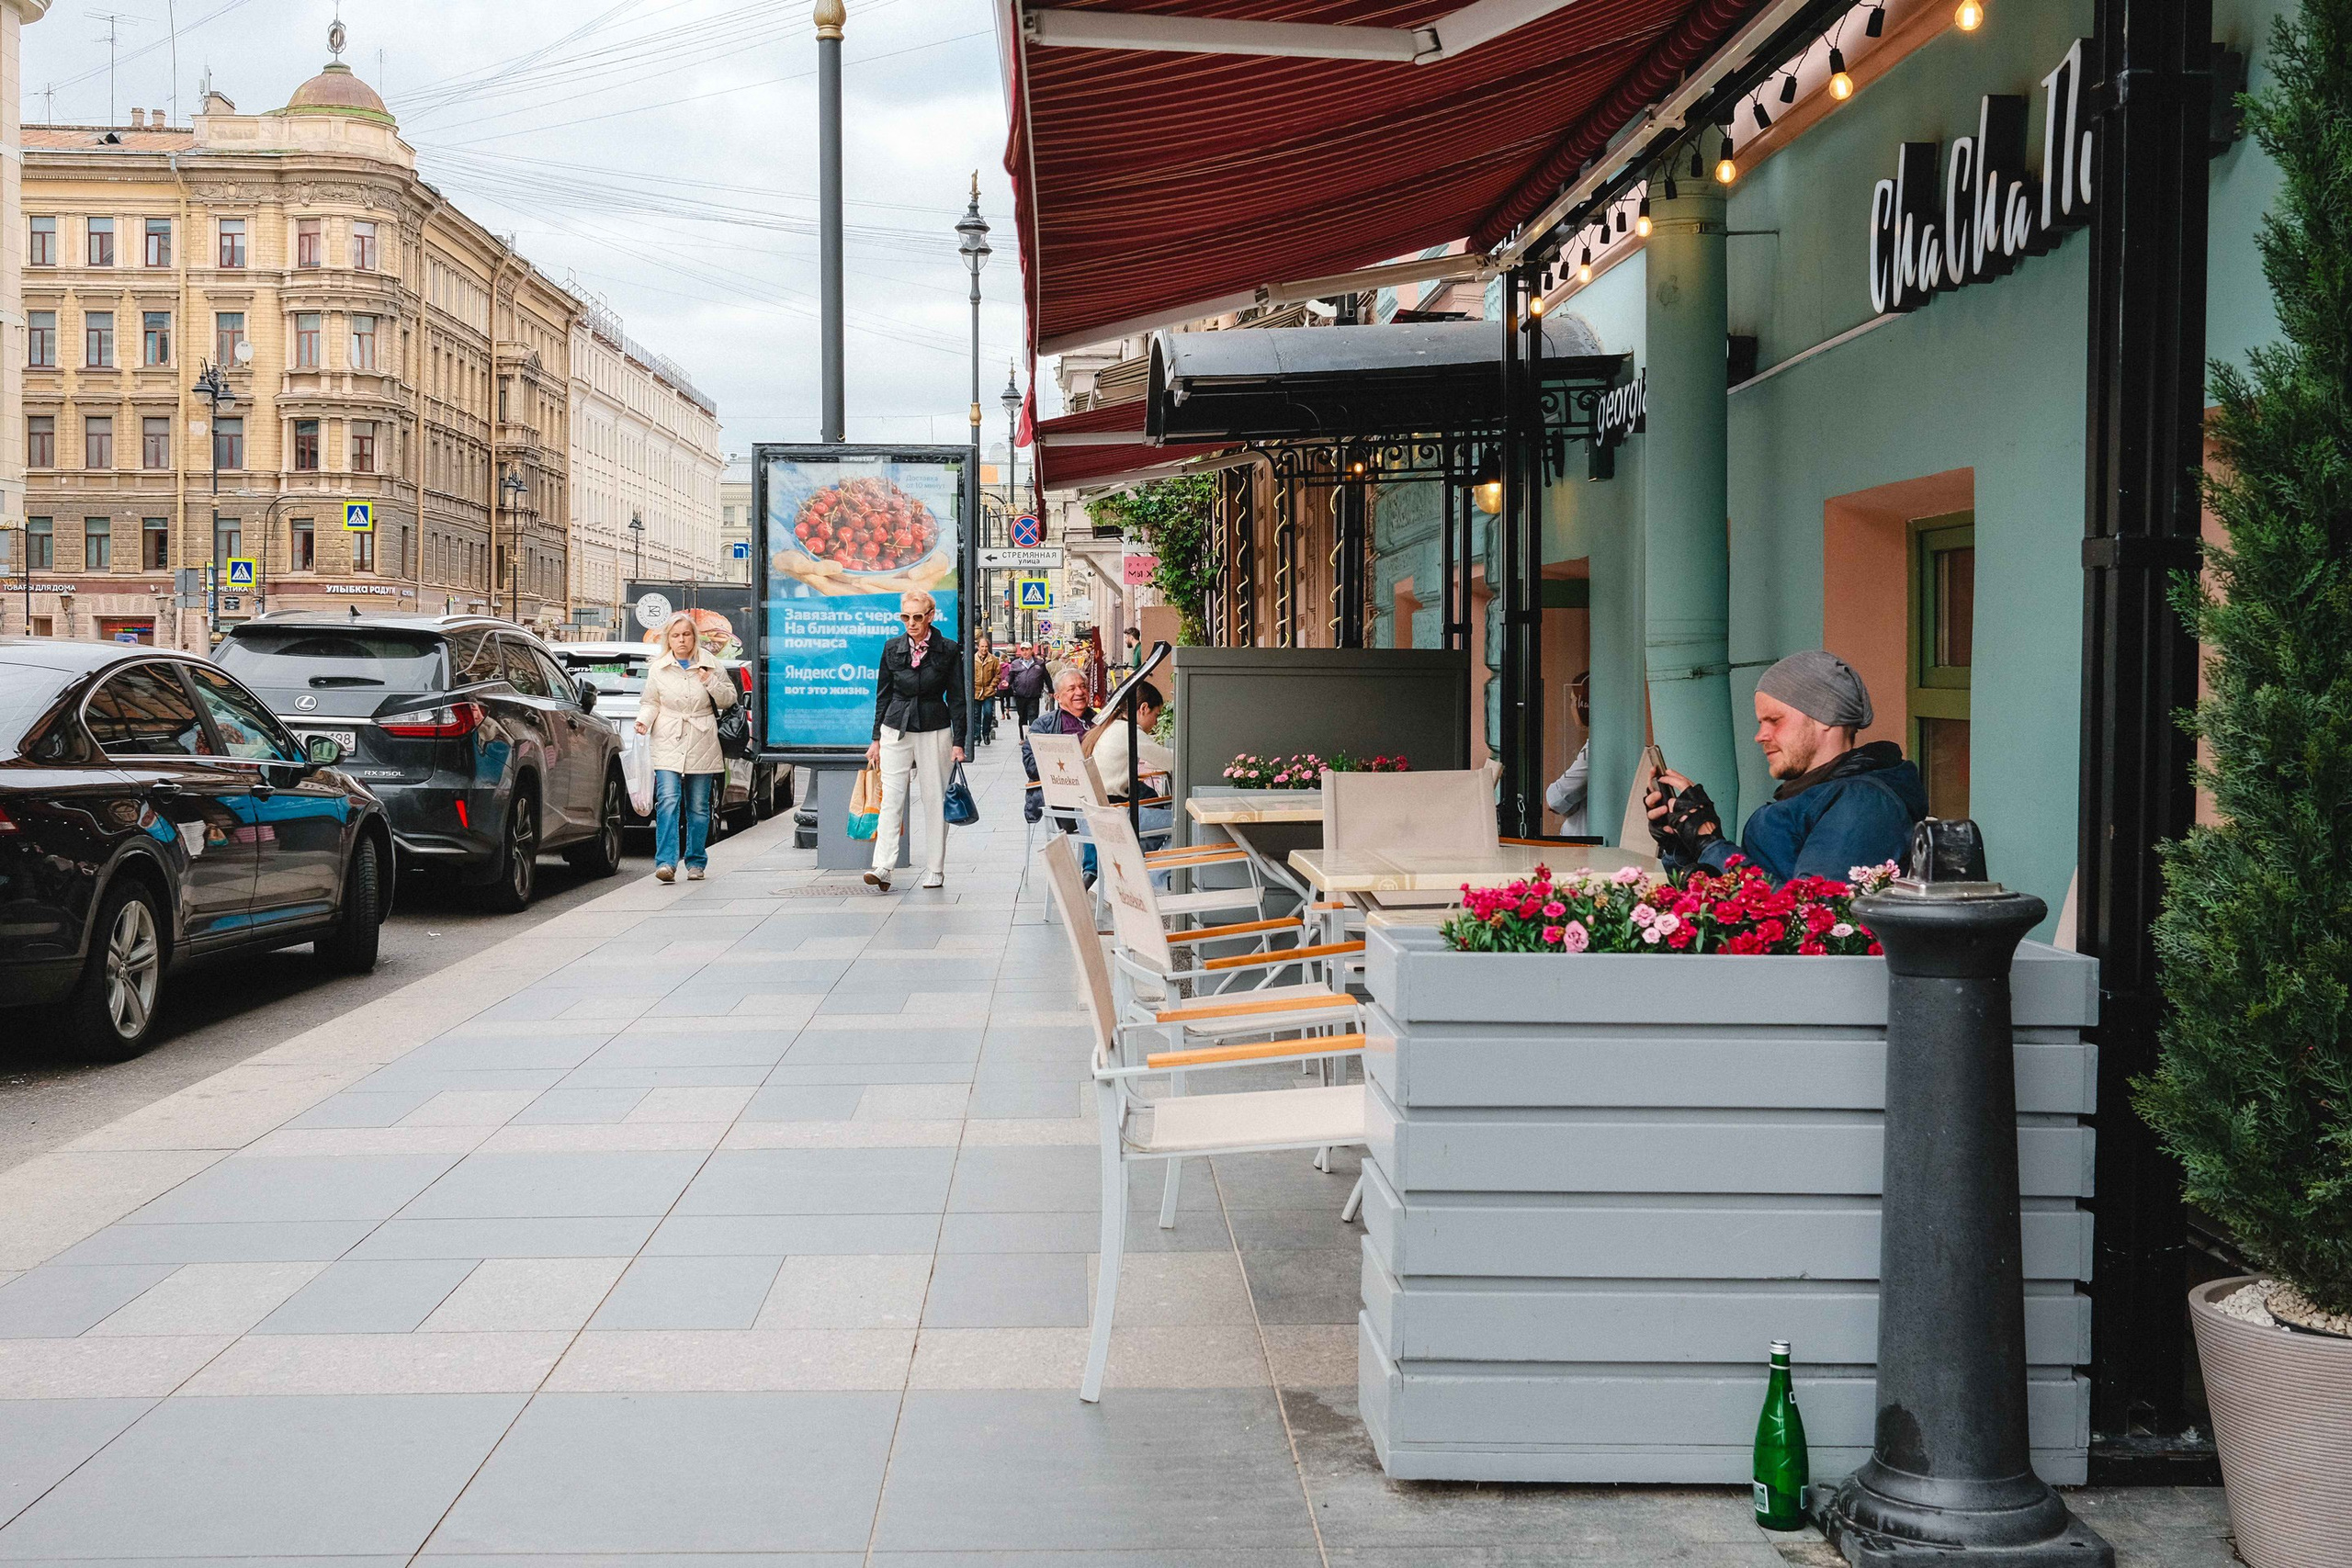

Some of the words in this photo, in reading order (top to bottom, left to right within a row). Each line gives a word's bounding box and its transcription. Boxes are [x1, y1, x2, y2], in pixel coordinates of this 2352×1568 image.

[906, 474, 939, 482] Доставка
[35, 584, 51, 592] ДЛЯ
[51, 584, 76, 592] ДОМА
[785, 608, 853, 622] Завязать
[854, 612, 864, 622] с
[865, 608, 948, 624] черей.
[785, 622, 805, 635] На
[807, 622, 899, 636] ближайшие
[785, 637, 847, 649] полчаса
[785, 665, 836, 681] Яндекс
[784, 686, 806, 694] вот
[807, 686, 828, 694] это
[830, 686, 870, 695] жизнь
[330, 733, 352, 745] 98
[379, 770, 405, 778] 350L
[1050, 774, 1080, 786] Heineken
